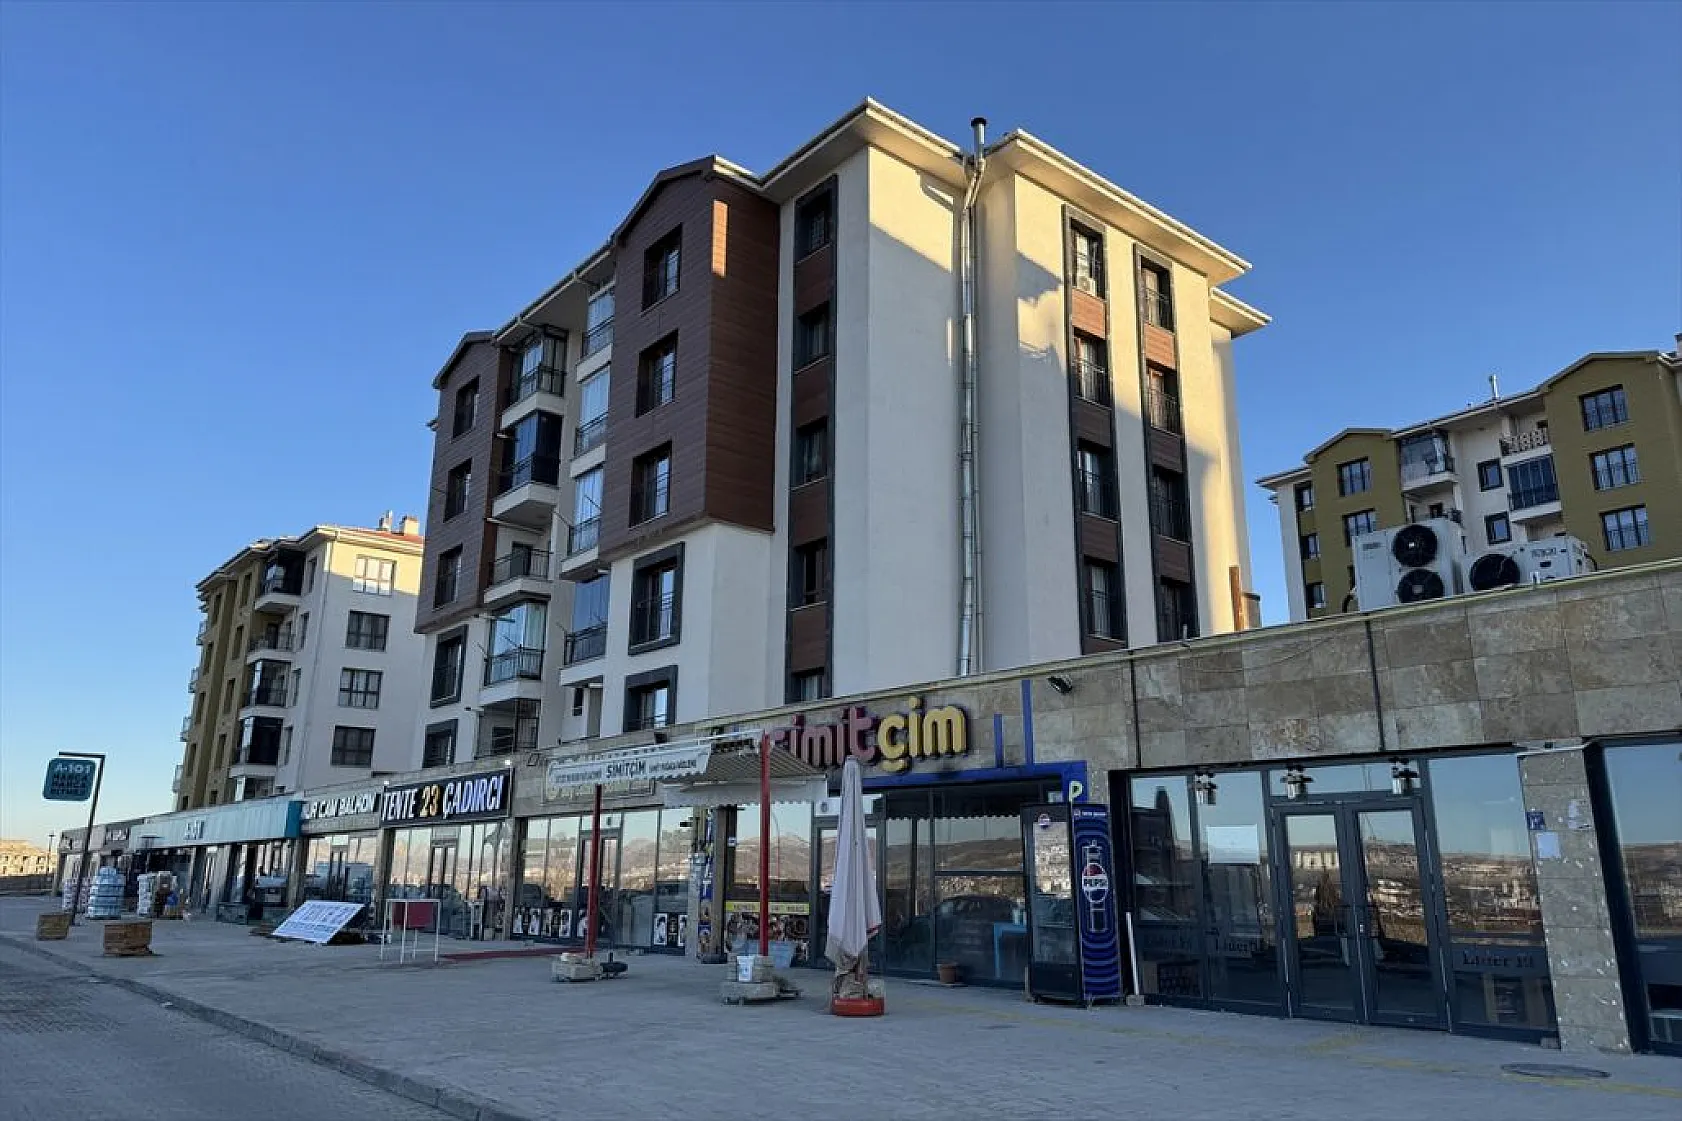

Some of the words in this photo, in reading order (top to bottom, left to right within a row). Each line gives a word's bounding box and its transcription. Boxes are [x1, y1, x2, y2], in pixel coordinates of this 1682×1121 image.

[383, 789, 417, 820] TENTE
[419, 783, 440, 818] 23
[443, 775, 504, 819] ÇADIRCI
[1083, 878, 1107, 889] PEPSI
